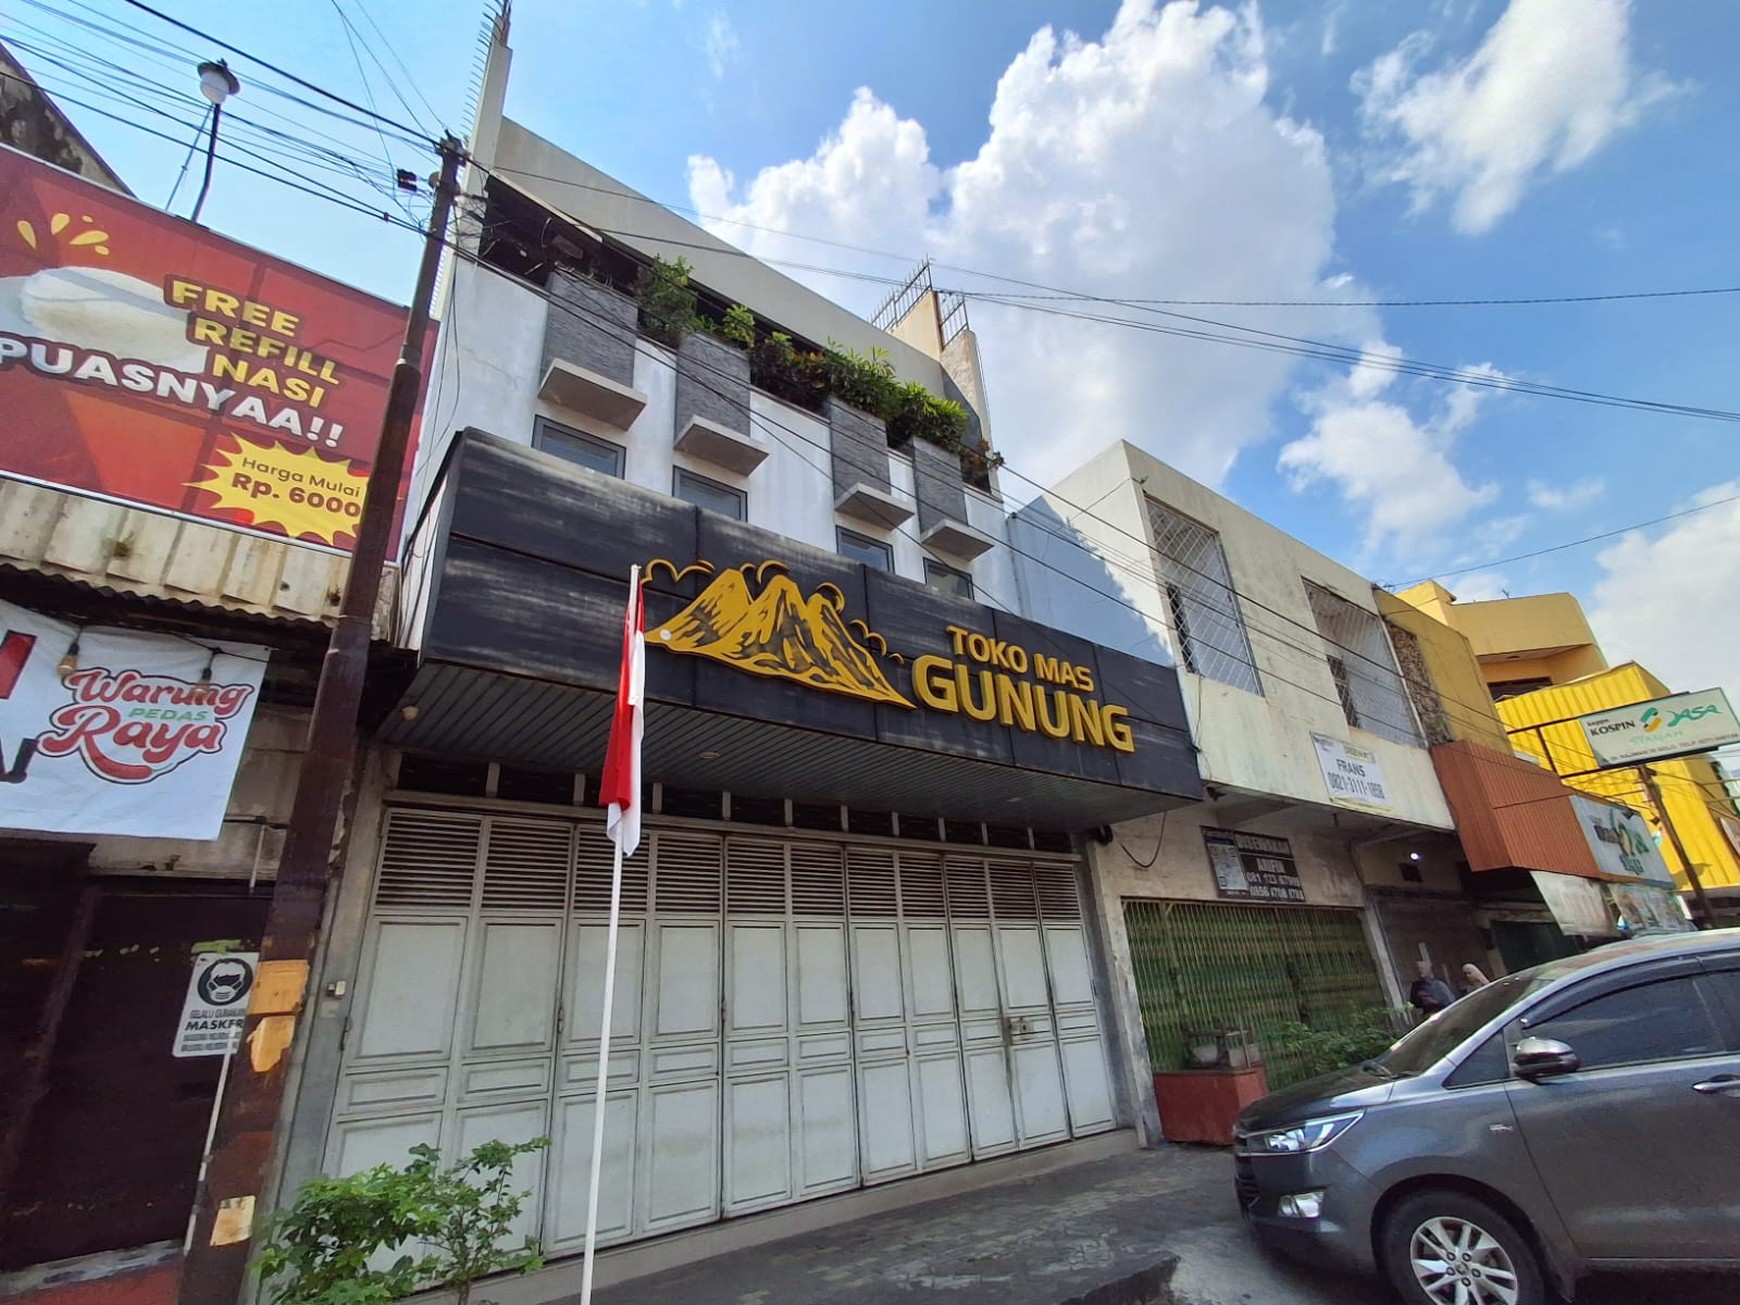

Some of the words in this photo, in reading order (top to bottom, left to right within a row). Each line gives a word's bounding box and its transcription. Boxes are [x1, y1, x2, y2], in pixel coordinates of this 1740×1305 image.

[169, 278, 301, 338] FREE
[193, 316, 343, 386] REFILL
[212, 353, 326, 409] NASI
[231, 473, 281, 500] Rp.
[287, 486, 362, 519] 6000
[242, 455, 304, 484] Harga
[308, 473, 362, 498] Mulai
[945, 625, 1028, 674] TOKO
[1034, 653, 1095, 693] MAS
[68, 669, 251, 716] Warung
[127, 707, 210, 722] PEDAS
[911, 654, 1136, 753] GUNUNG
[42, 704, 222, 780] Raya
[1590, 720, 1636, 737] KOSPIN
[1335, 758, 1367, 777] FRANS
